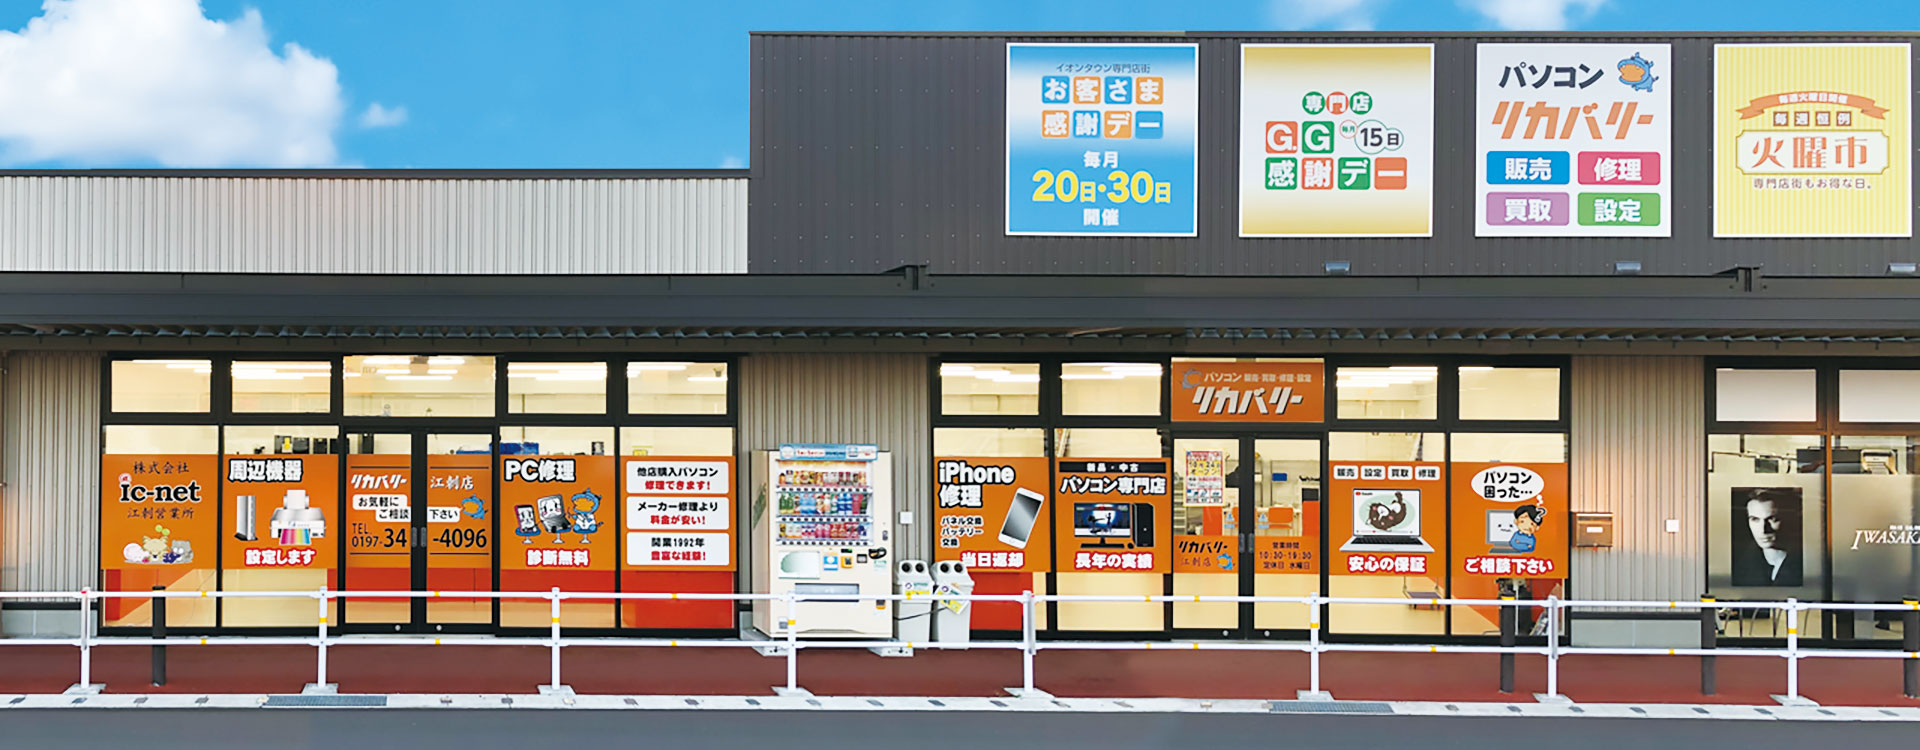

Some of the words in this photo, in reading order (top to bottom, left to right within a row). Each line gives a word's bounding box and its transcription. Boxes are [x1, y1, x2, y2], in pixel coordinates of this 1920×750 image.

[1056, 63, 1150, 73] イオンタウン専門店街
[1499, 61, 1604, 89] パソコン
[1043, 77, 1163, 103] お客さま
[1303, 92, 1372, 114] 専門店
[1043, 112, 1163, 138] 感謝デー
[1491, 101, 1654, 140] リカバリー
[1341, 125, 1356, 134] 毎月
[1083, 151, 1119, 169] 毎月
[1751, 136, 1867, 169] 火曜市
[1266, 159, 1406, 188] 感謝デー
[1505, 157, 1552, 181] 販売
[1594, 157, 1642, 181] 修理
[1083, 208, 1119, 226] 開催
[1504, 199, 1551, 222] 買取
[1594, 199, 1641, 222] 設定
[1204, 372, 1242, 383] パソコン
[1192, 386, 1303, 414] リカバリー
[133, 461, 190, 474] 株式会社
[229, 460, 303, 482] 周辺機器
[504, 460, 575, 481] PC修理
[637, 467, 718, 477] 他店購入パソコン
[938, 460, 1015, 485] iPhone
[1336, 468, 1355, 478] 販売
[1364, 468, 1382, 478] 設定
[1391, 468, 1409, 478] 買取
[1418, 469, 1436, 479] 修理
[350, 474, 407, 489] リカバリー
[430, 476, 474, 490] 江刺店
[1060, 477, 1167, 495] パソコン専門店
[1484, 472, 1532, 484] パソコン
[119, 475, 202, 502] ic-net
[939, 484, 982, 507] 修理
[358, 497, 399, 507] お気軽に
[637, 501, 718, 512] メーカー修理より
[127, 507, 194, 520] 江刺営業所
[379, 509, 409, 519] ご相談
[429, 509, 458, 519] 下さい
[941, 528, 982, 536] バッテリー
[1850, 530, 1920, 550] IWASAK
[651, 538, 705, 548] 開業1992年
[1179, 541, 1228, 553] リカバリー
[245, 549, 315, 565] 設定します
[526, 549, 590, 566] 診断無料
[961, 552, 1025, 568] 当日返却
[1075, 553, 1153, 569] 長年の実績
[1348, 555, 1426, 573] 安心の保証
[1465, 557, 1553, 574] ご相談下さい
